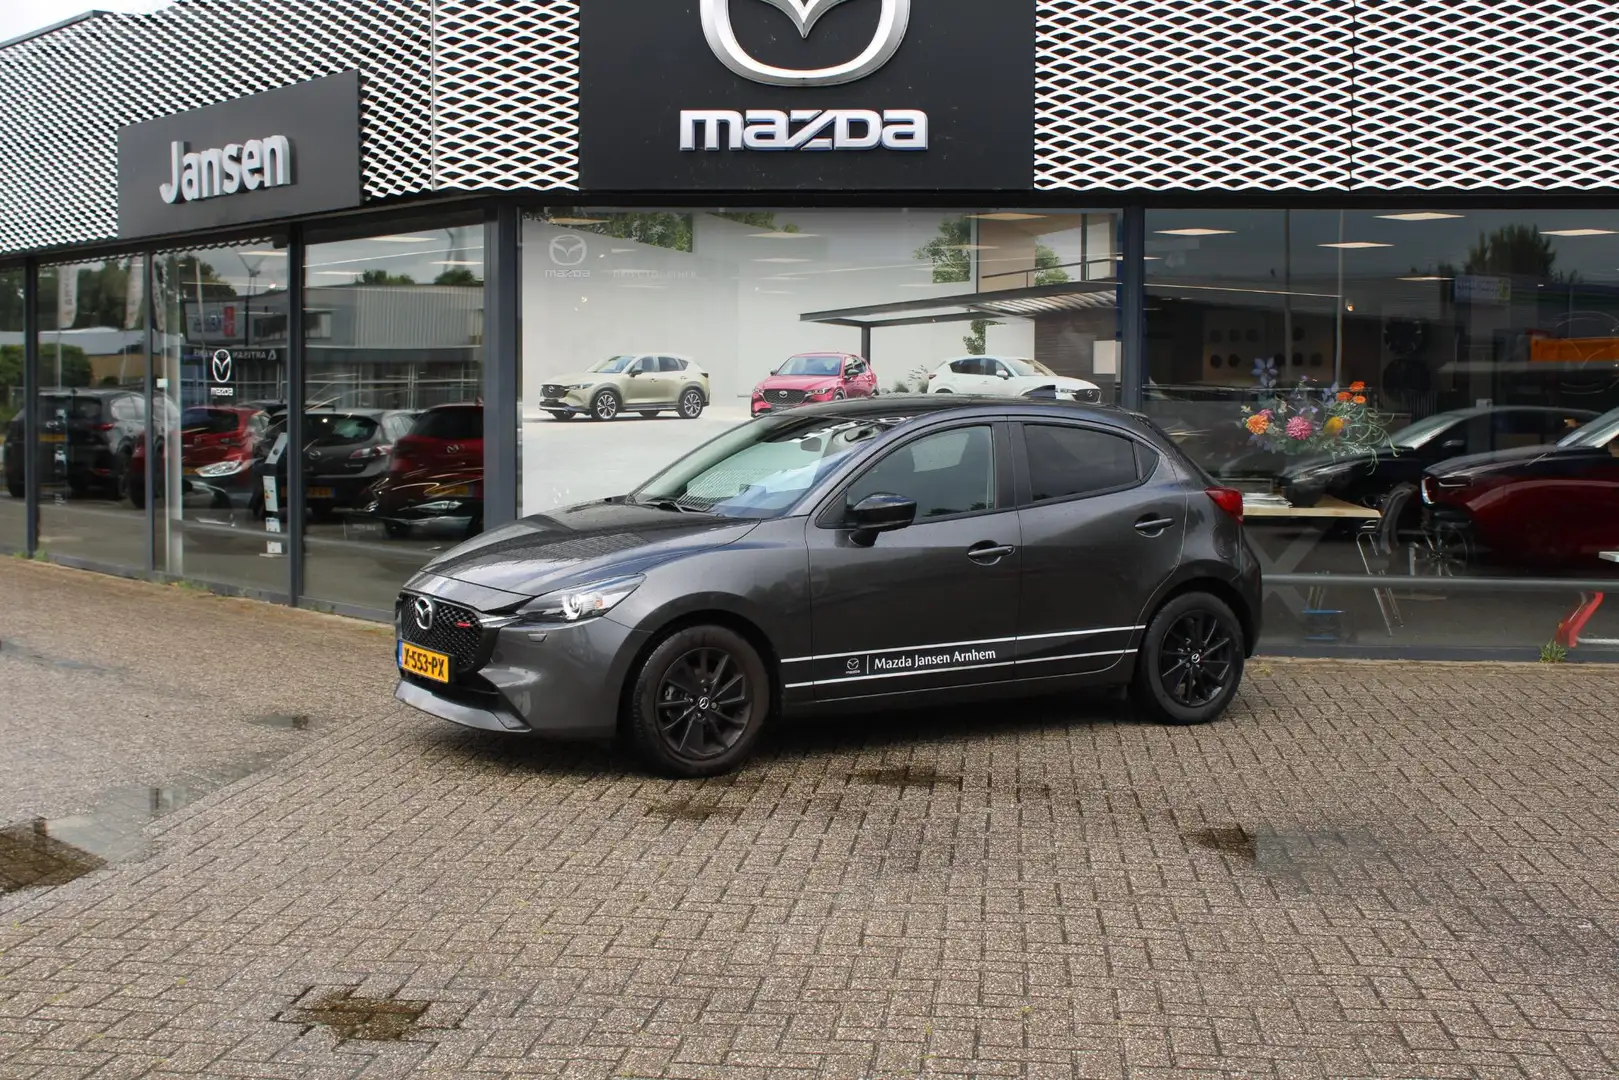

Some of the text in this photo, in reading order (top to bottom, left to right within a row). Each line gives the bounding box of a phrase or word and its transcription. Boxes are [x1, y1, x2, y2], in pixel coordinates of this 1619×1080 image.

[159, 134, 291, 204] Jansen
[402, 646, 445, 679] X-553-PX
[874, 648, 996, 670] Mazda Jansen Arnhem
